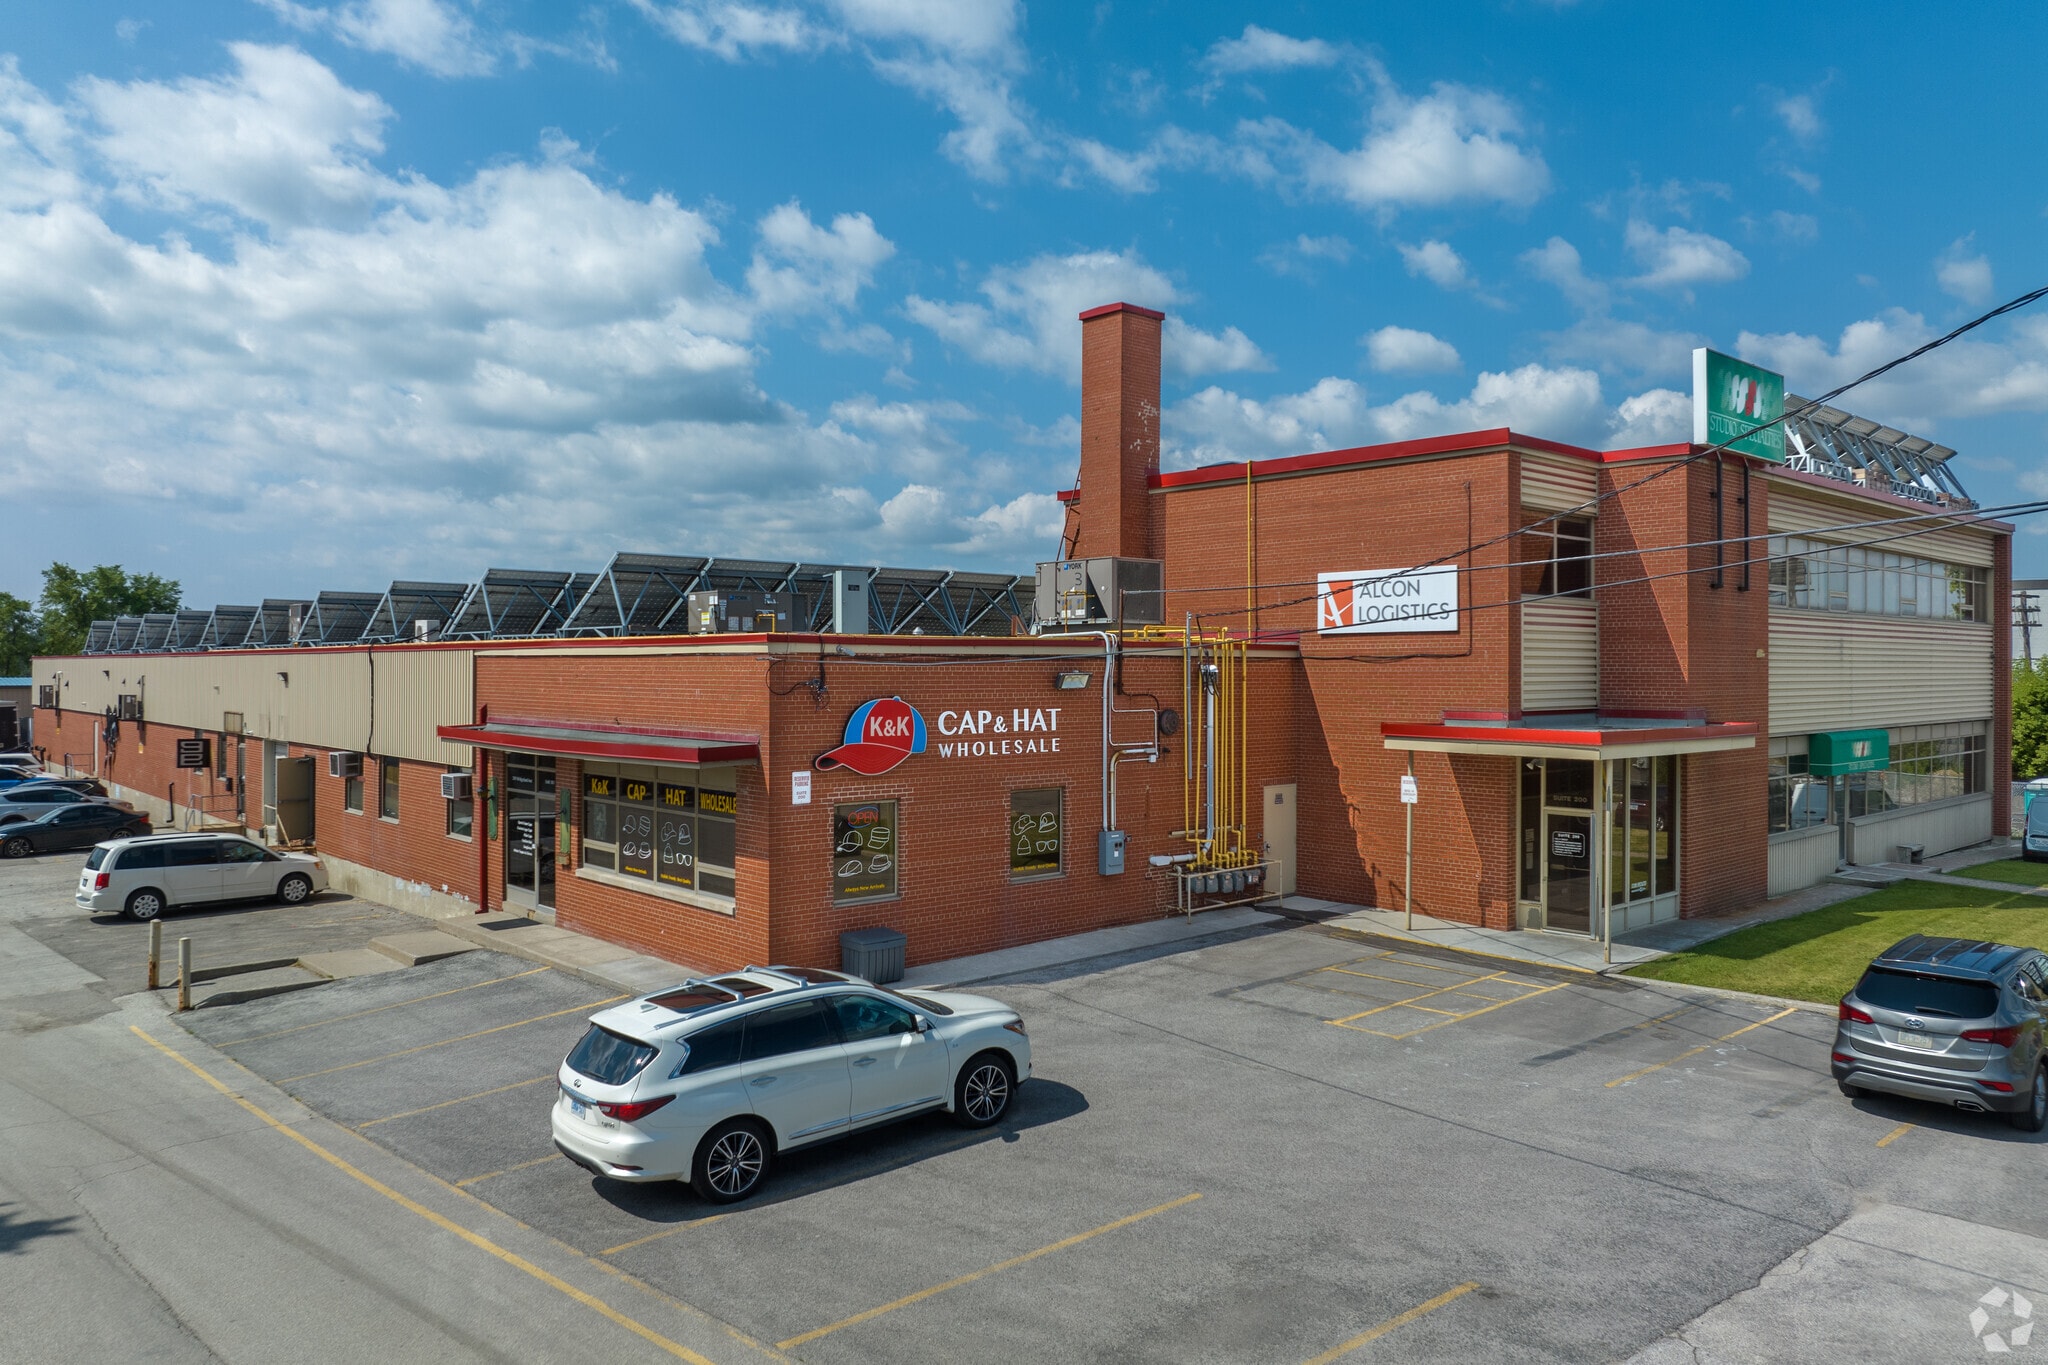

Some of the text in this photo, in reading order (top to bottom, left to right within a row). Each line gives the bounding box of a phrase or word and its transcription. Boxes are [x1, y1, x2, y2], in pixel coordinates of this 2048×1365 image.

[1710, 415, 1737, 436] STUDIO
[1075, 572, 1083, 586] 3
[1359, 579, 1420, 599] ALCON
[1358, 602, 1450, 622] LOGISTICS
[870, 716, 910, 737] K&K
[937, 710, 992, 736] CAP
[1013, 708, 1062, 732] HAT
[938, 738, 1060, 758] WHOLESALE
[591, 778, 737, 814] K&K CAP HAT WHOLESALE
[847, 811, 879, 825] OPEN
